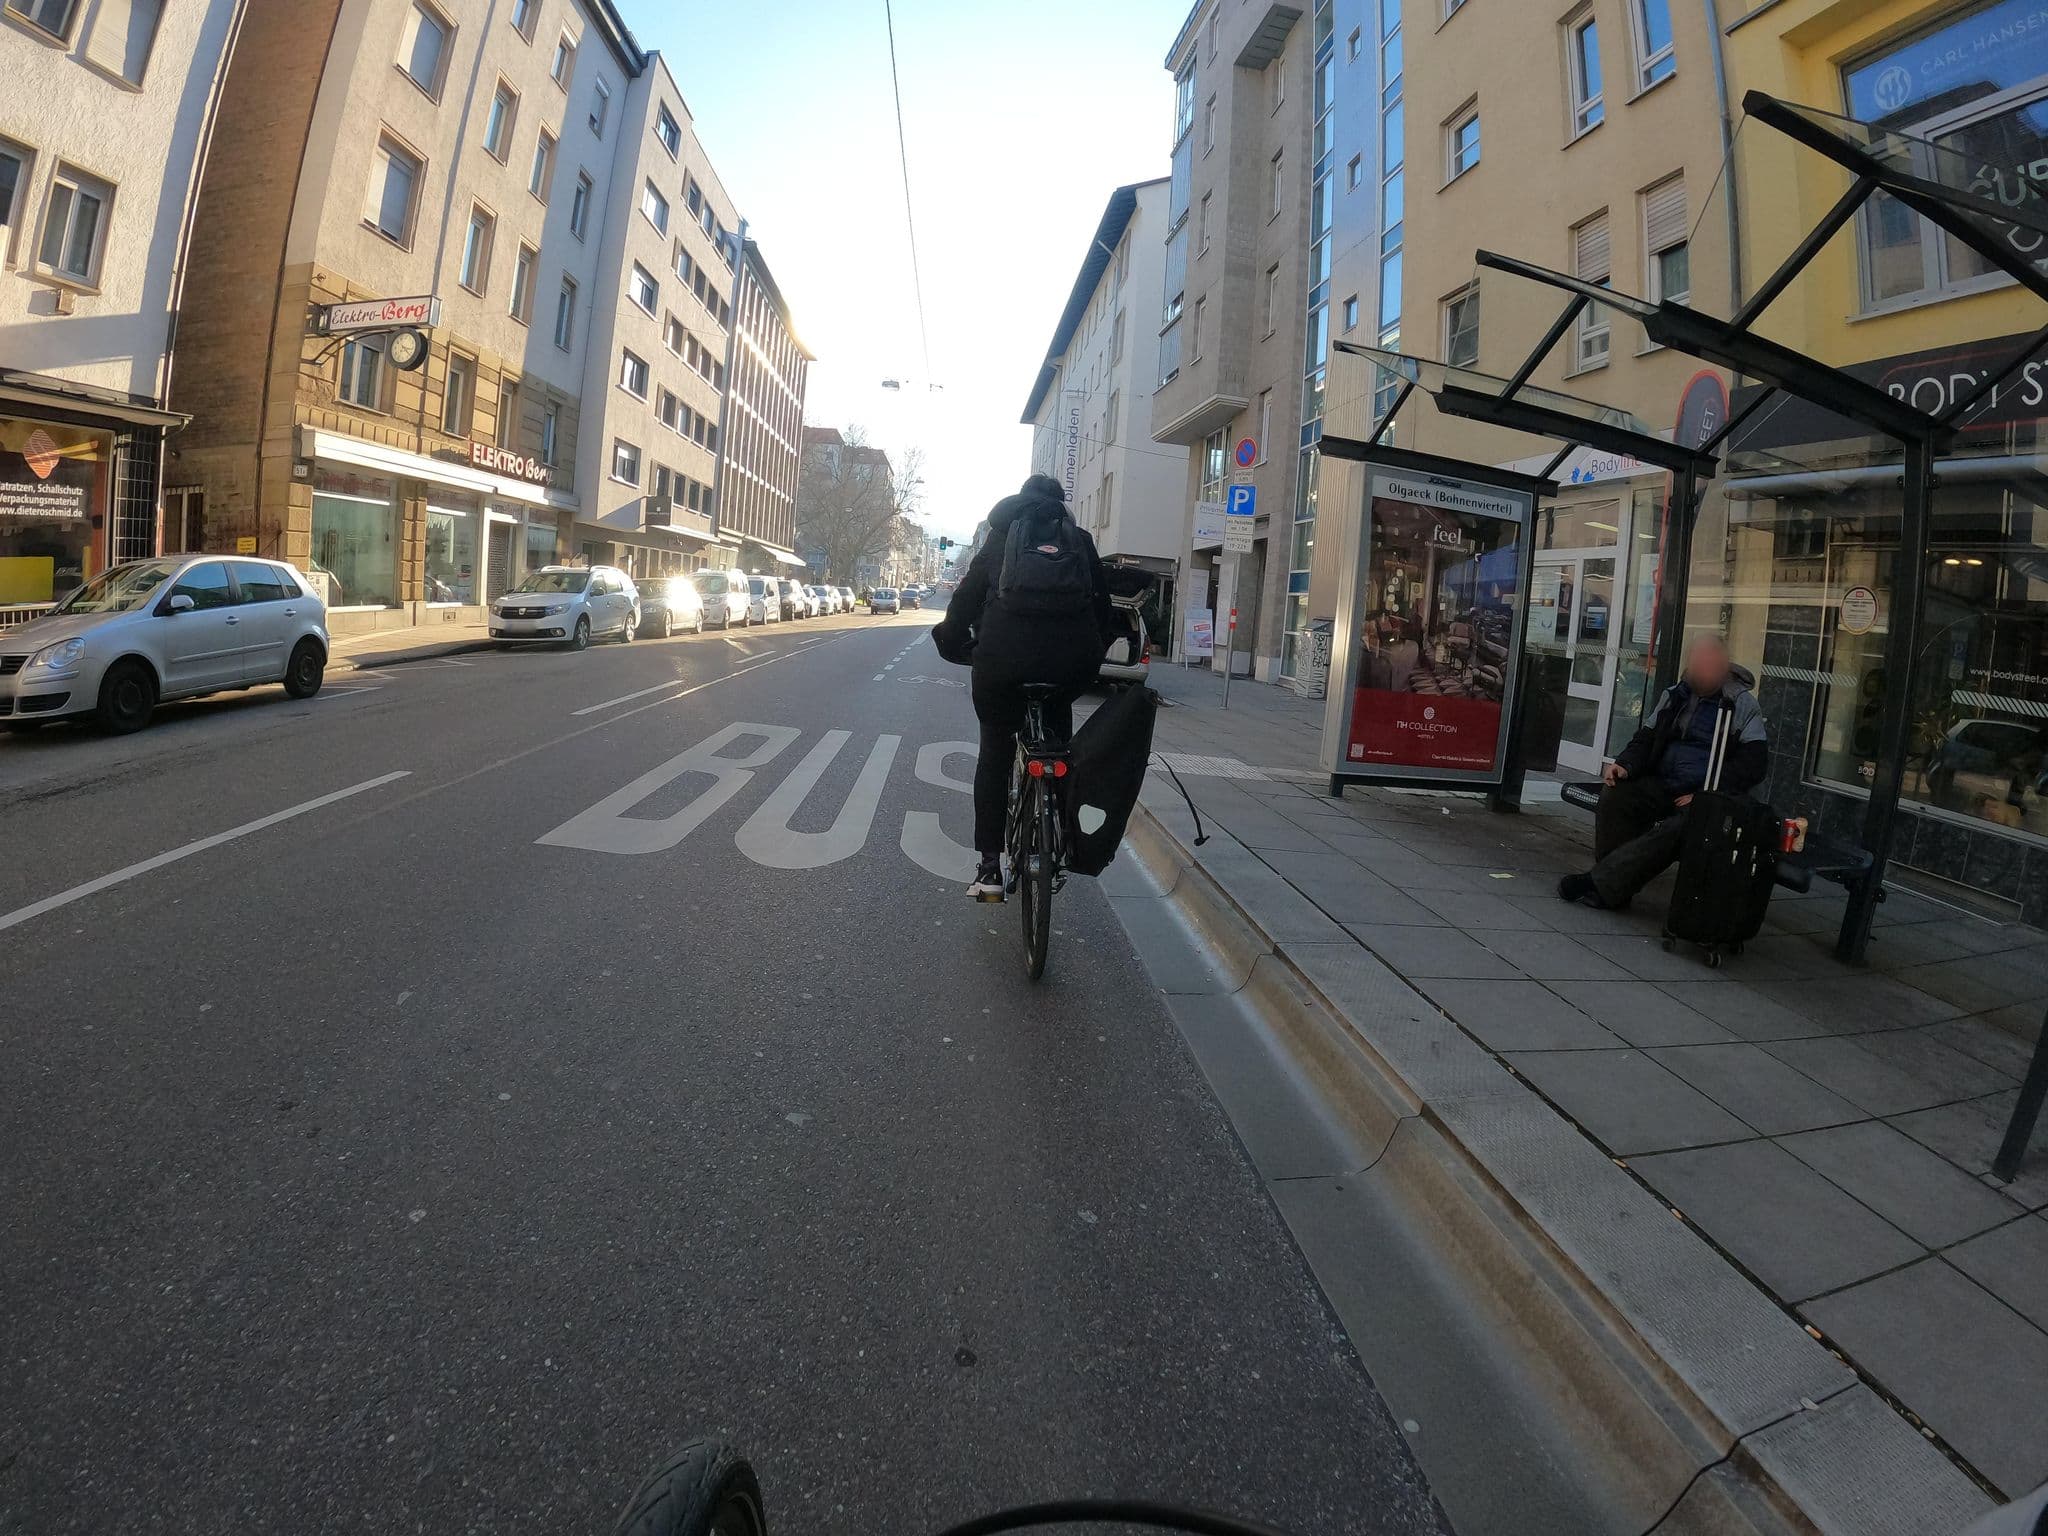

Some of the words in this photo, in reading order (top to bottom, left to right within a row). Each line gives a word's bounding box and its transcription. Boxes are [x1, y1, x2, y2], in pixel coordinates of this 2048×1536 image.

[331, 301, 430, 325] Elektro-Berg
[472, 442, 525, 475] ELEKTRO
[524, 457, 555, 485] Berg
[1064, 407, 1080, 503] blumenladen
[0, 482, 36, 494] atratzen,
[37, 483, 83, 496] Schallschutz
[1234, 488, 1250, 512] P
[1388, 482, 1432, 500] Olgaeck
[1435, 490, 1513, 516] (Bohnenviertel)
[1433, 524, 1462, 545] feel
[1408, 721, 1458, 734] COLLECTION
